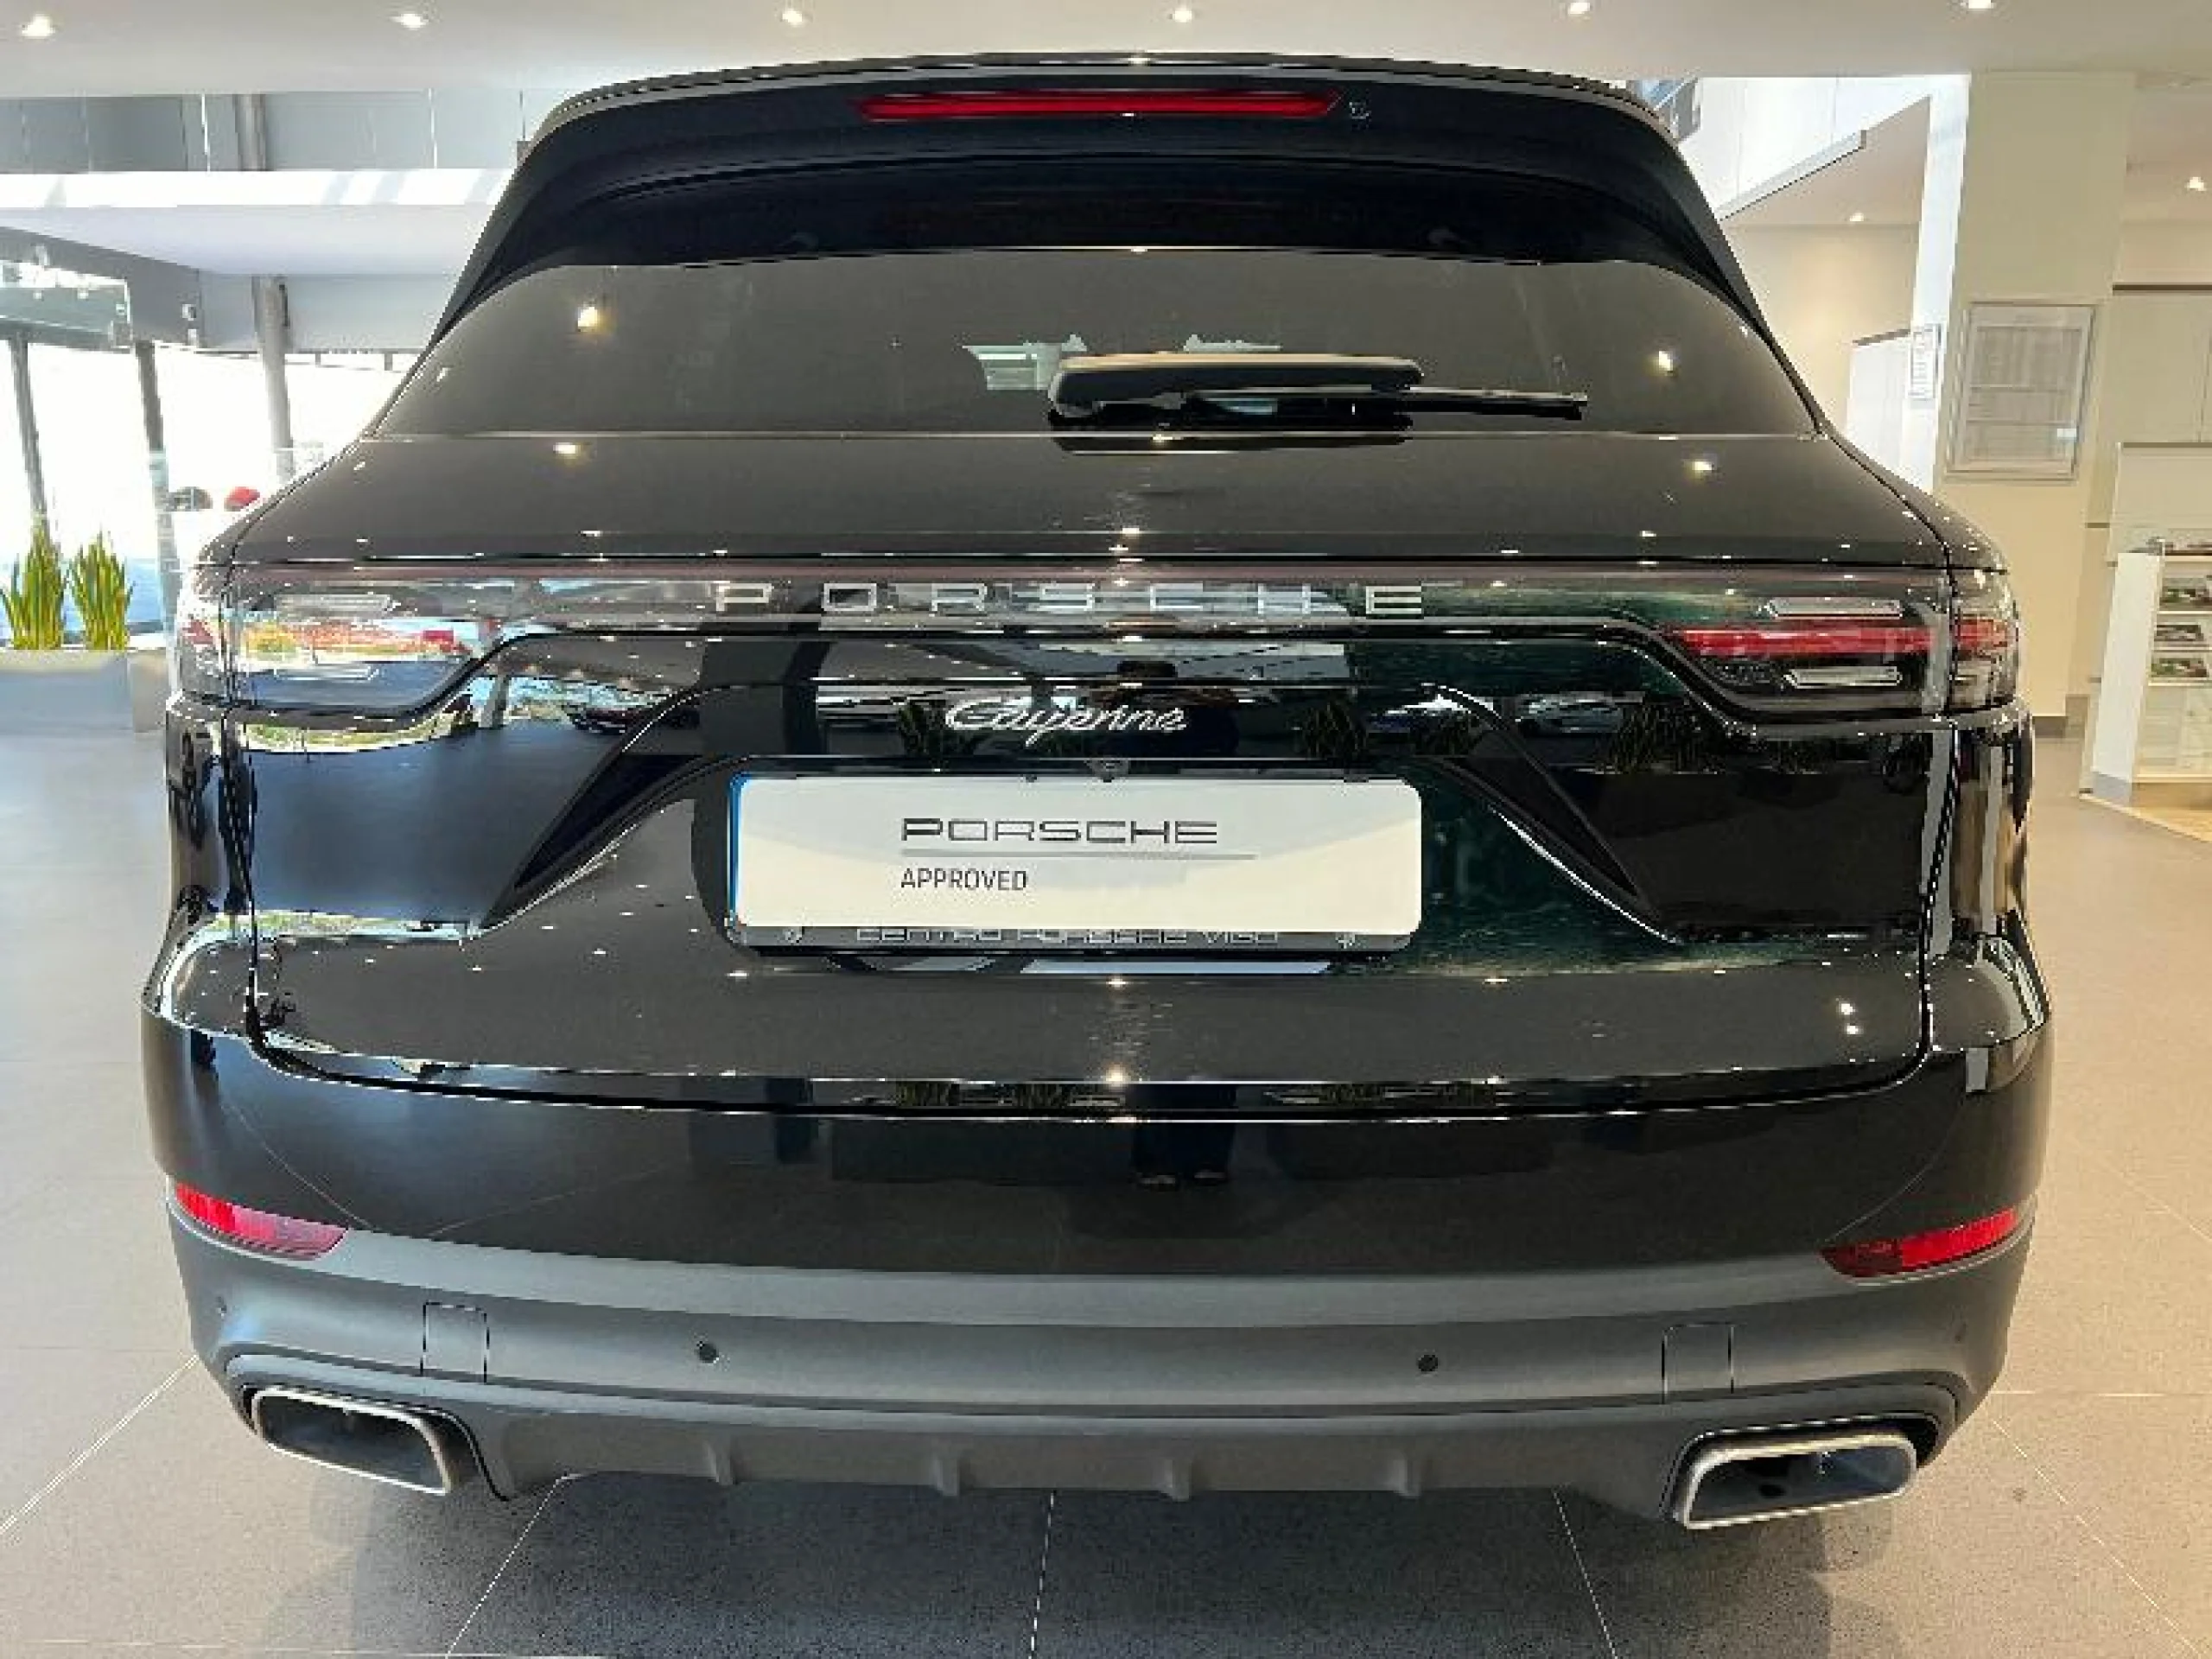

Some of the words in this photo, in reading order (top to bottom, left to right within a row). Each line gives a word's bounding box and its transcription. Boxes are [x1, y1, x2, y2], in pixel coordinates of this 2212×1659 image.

[715, 582, 1422, 615] PORSCHE
[944, 696, 1187, 747] Cayenne
[900, 817, 1218, 844] PORSCHE
[900, 868, 1028, 891] APPROVED
